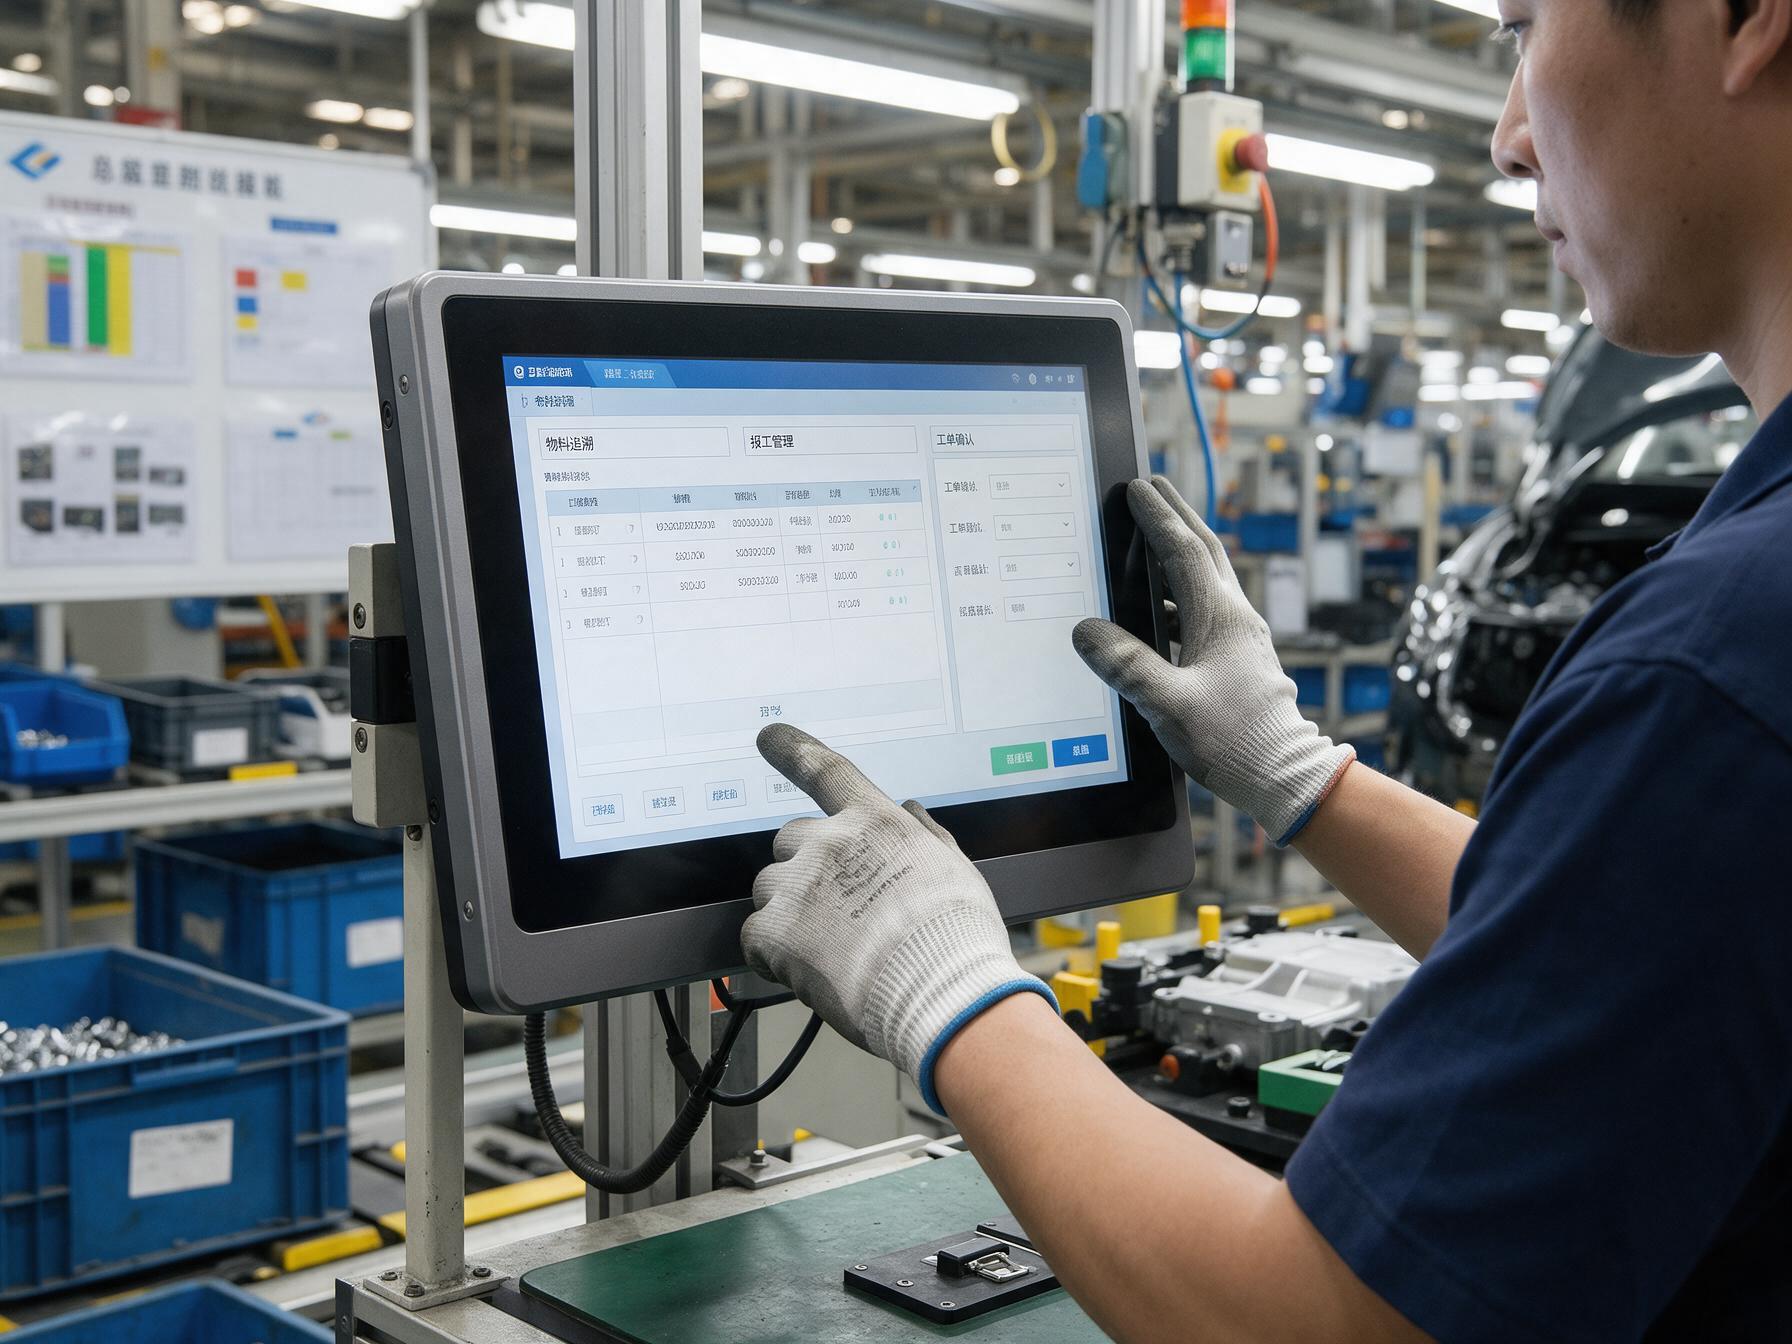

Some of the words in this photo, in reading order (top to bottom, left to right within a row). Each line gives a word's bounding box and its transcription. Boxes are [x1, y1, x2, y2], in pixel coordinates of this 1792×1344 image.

[750, 434, 795, 449] 报工管理
[936, 432, 975, 446] 工单确认
